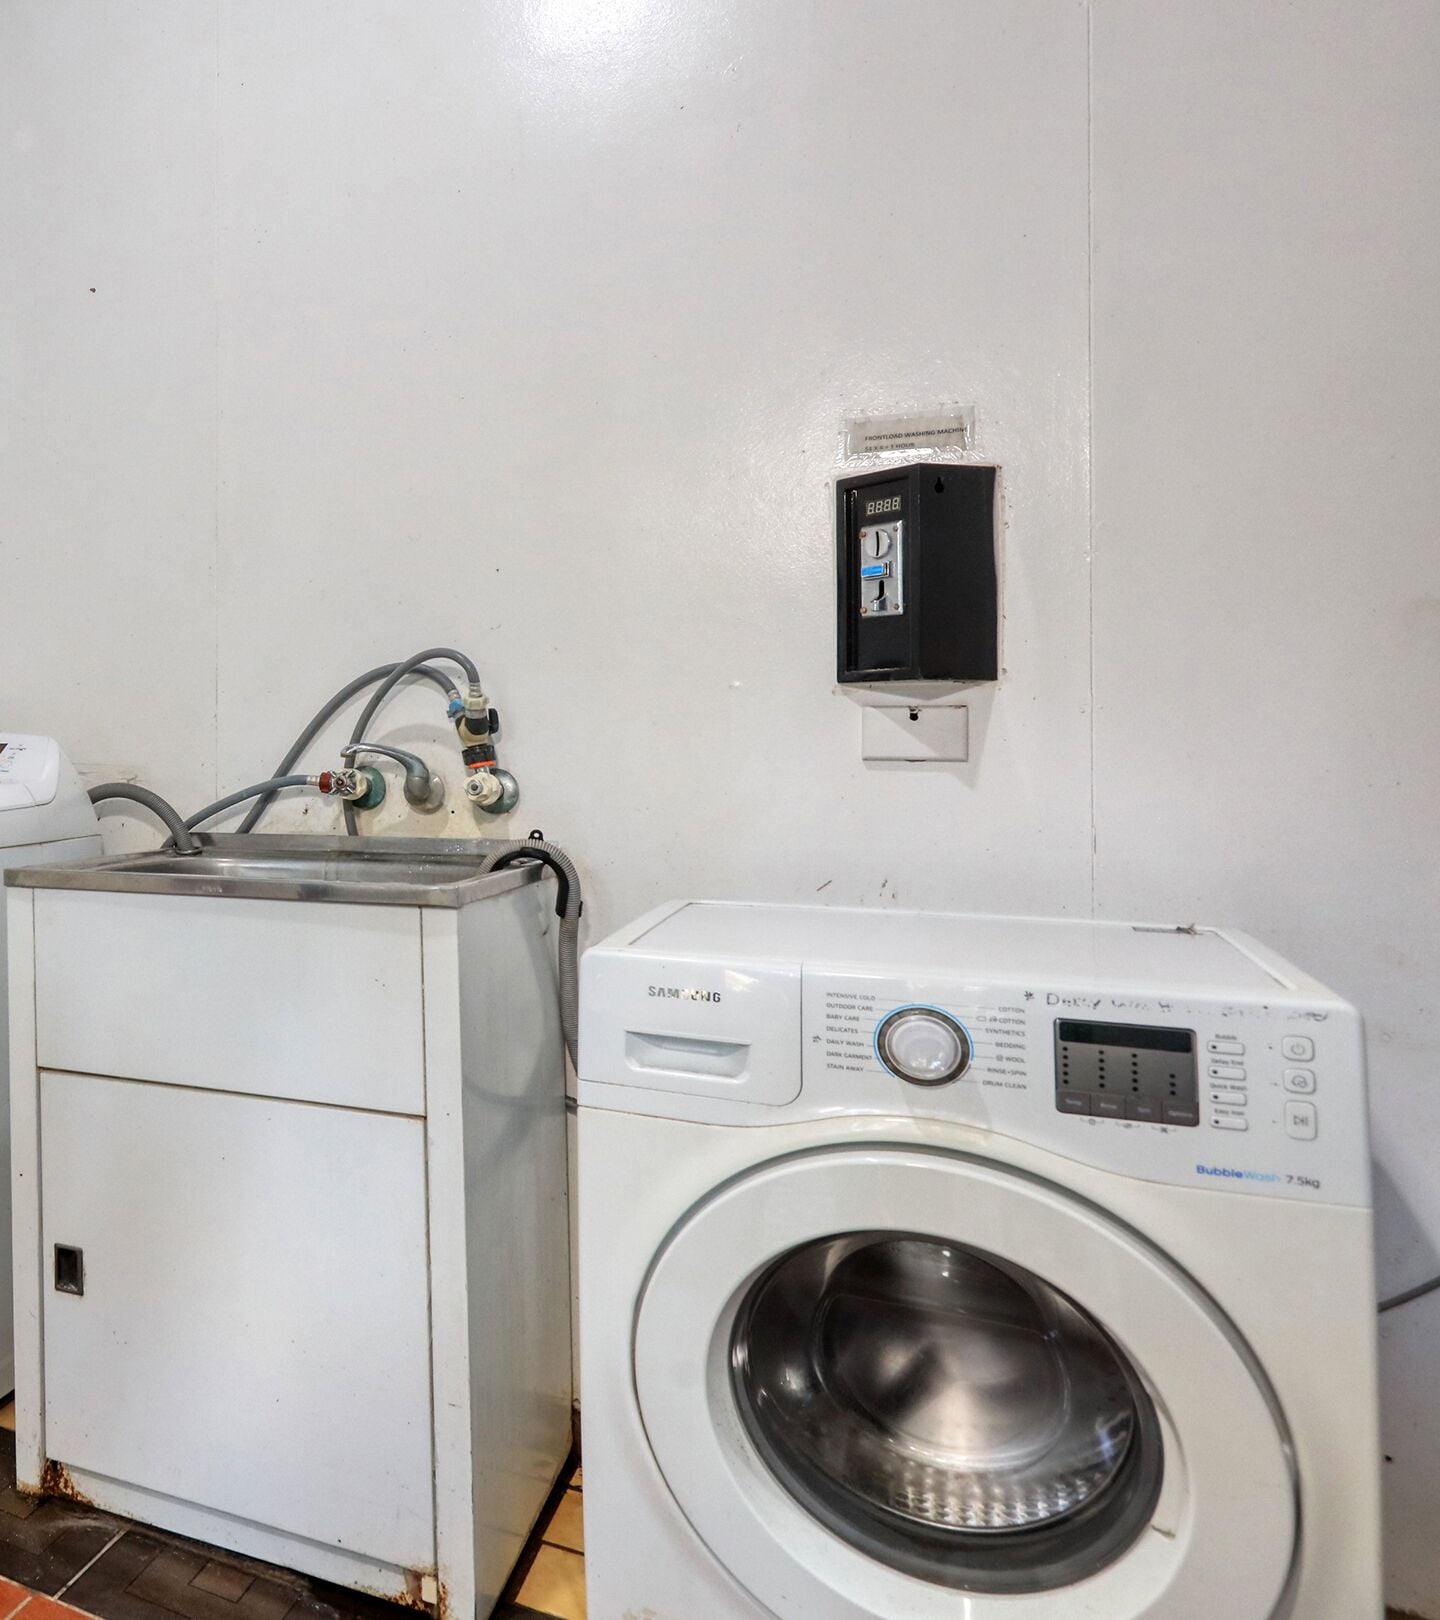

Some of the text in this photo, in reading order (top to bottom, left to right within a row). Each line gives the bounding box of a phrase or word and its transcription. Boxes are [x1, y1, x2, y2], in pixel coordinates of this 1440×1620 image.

[865, 433, 903, 441] FRONTLOAD
[826, 992, 857, 1000] INTENSIVE
[998, 1006, 1025, 1014] COTTON
[999, 1017, 1026, 1025] COTTON
[826, 1026, 859, 1034] DELICATES
[985, 1027, 1026, 1037] SYNTHETICS
[995, 1041, 1026, 1050] BEDDING
[1005, 1056, 1026, 1064] WOOL
[1004, 1081, 1027, 1089] CLEAN
[1196, 1165, 1320, 1189] BubbleWash 7.5kg
